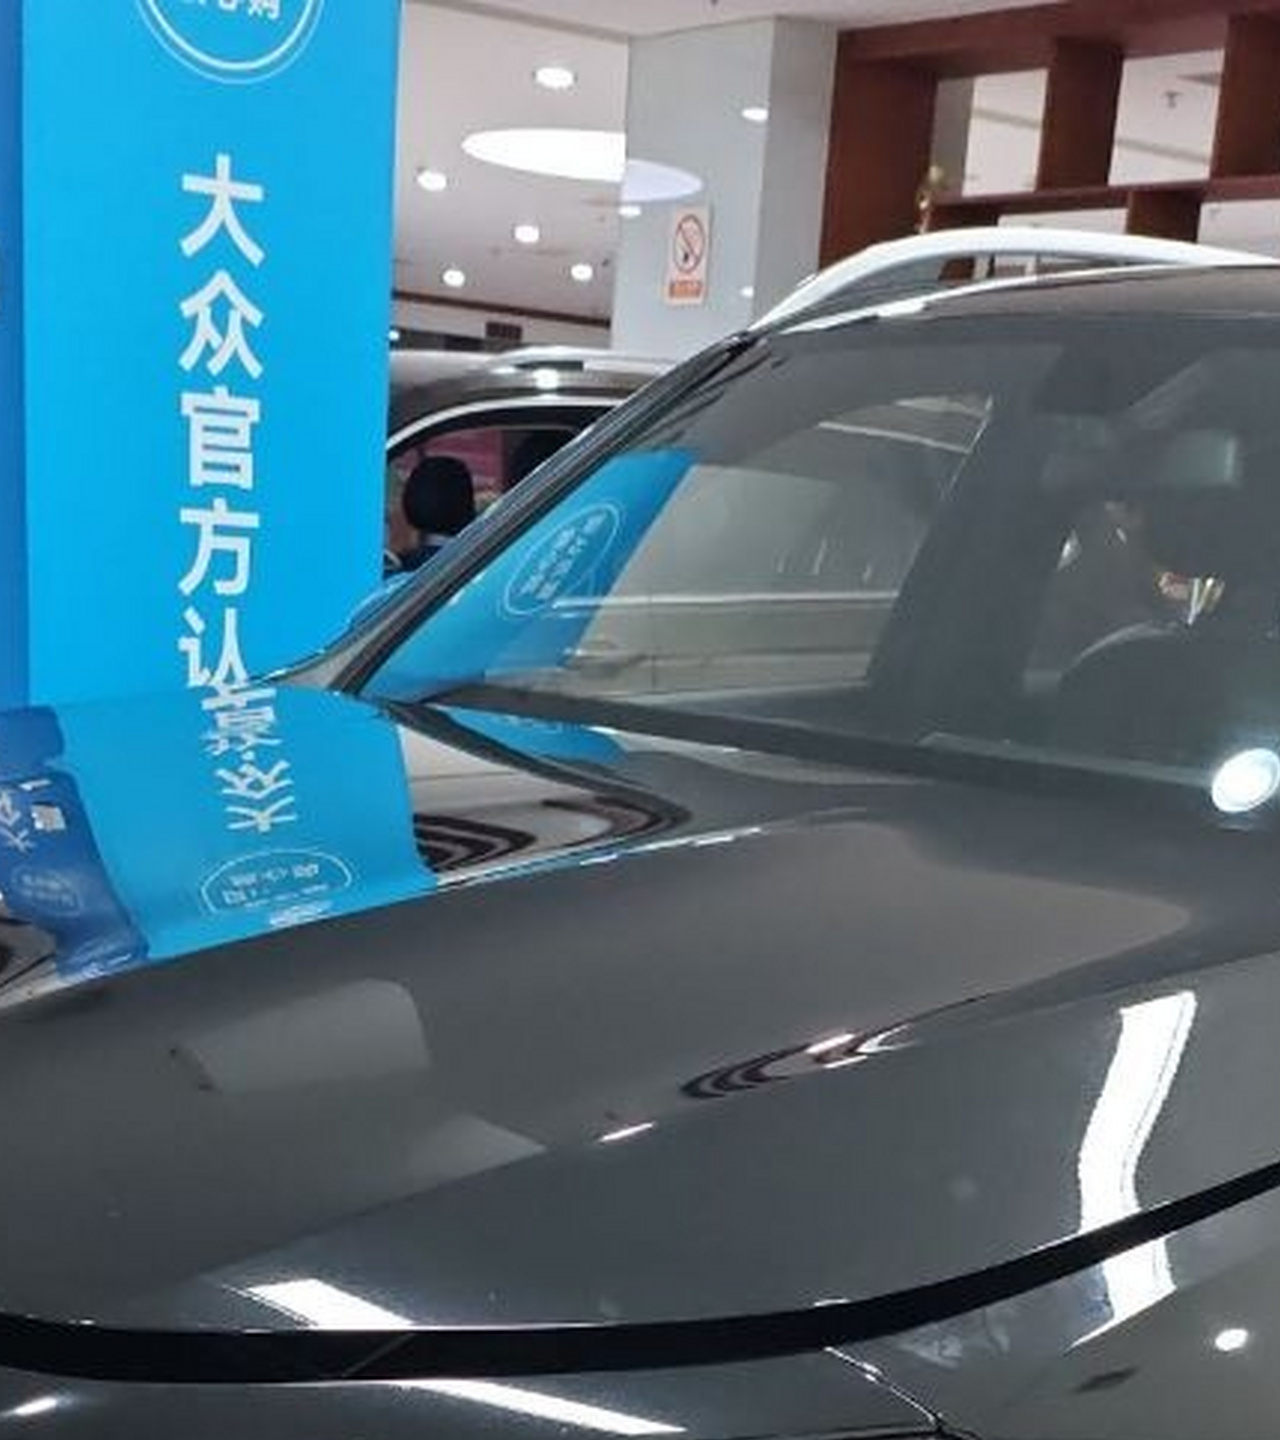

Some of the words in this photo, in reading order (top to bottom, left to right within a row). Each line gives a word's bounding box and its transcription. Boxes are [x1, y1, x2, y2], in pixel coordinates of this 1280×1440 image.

[178, 153, 266, 687] 大众官方认
